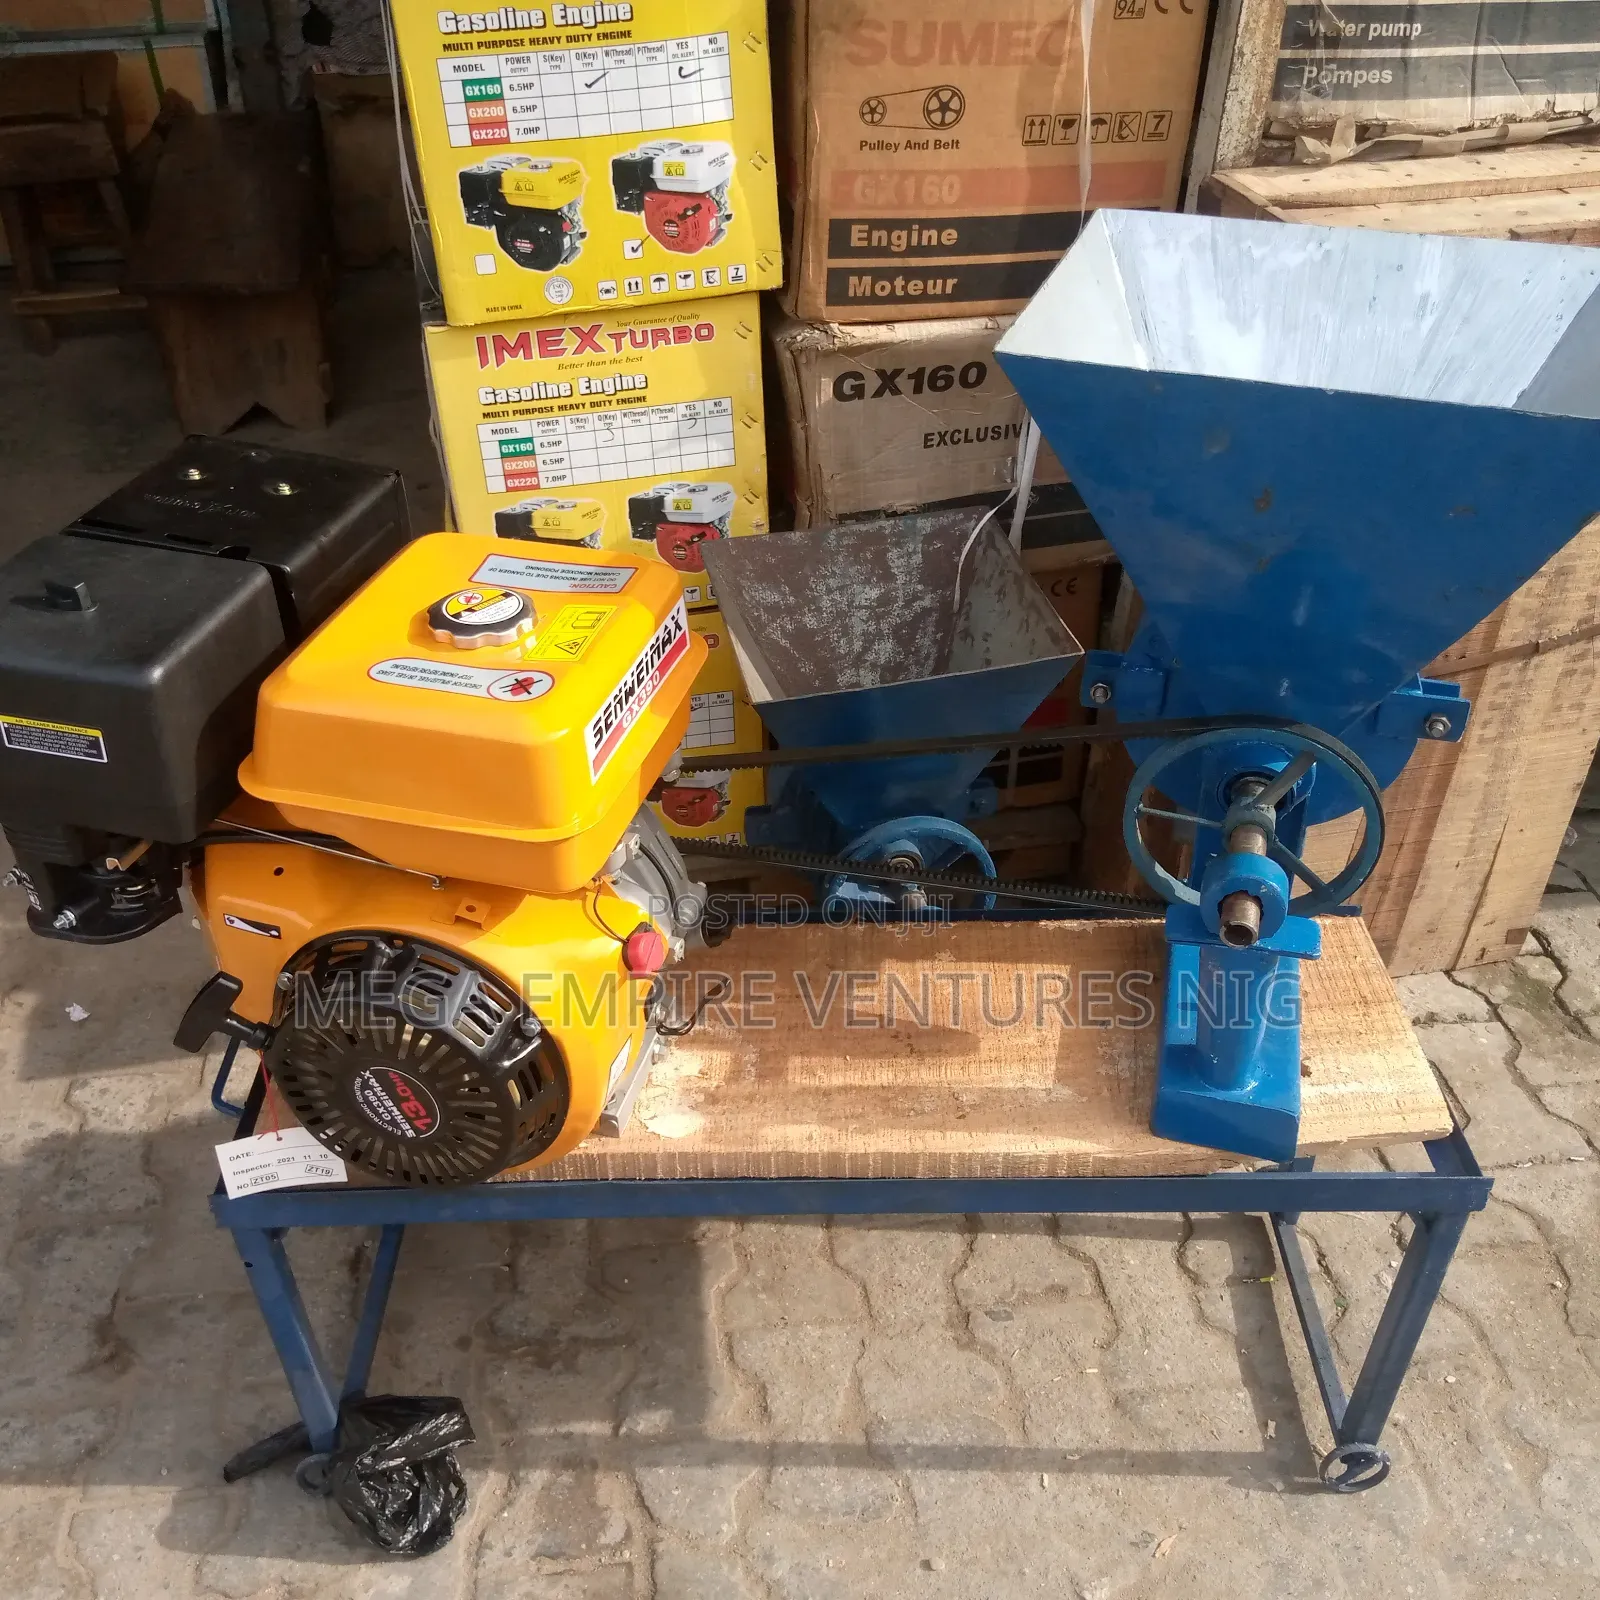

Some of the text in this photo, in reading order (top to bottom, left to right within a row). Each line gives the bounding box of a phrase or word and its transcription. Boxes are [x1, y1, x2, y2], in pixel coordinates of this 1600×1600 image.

[437, 2, 633, 35] Gasoline Engine
[1368, 22, 1422, 41] pump
[442, 30, 633, 52] MULTI PURPOSE HEAVY DUTY ENGINE
[676, 41, 690, 50] YES
[708, 37, 718, 46] NO
[844, 19, 1080, 67] SUMEC
[604, 47, 635, 58] W(Thread)
[637, 44, 666, 55] P(Thread)
[505, 56, 532, 65] POWER
[542, 54, 566, 63] S(Key)
[453, 61, 486, 73] MODEL
[510, 66, 529, 74] OUTPUT
[1303, 64, 1393, 88] Pompes
[465, 84, 502, 97] GX160
[509, 82, 535, 92] 6.5HP
[469, 106, 505, 119] GX200
[512, 104, 538, 114] 6.5HP
[472, 128, 508, 140] GX220
[515, 126, 541, 136] 7.0HP
[859, 137, 960, 153] Pulley And Belt
[853, 173, 963, 206] GX160
[850, 223, 958, 252] Engine
[848, 274, 958, 298] Moteur
[617, 313, 701, 328] Your Guarantee of Quality
[475, 322, 716, 371] IMEX TURBO
[557, 355, 643, 371] Better than the best
[832, 360, 988, 403] GX160
[477, 372, 649, 406] Gasoline Engine
[482, 395, 648, 419] MULTI PURPOSE HEAVY DUTY ENGINE
[685, 403, 697, 411] YES
[713, 400, 723, 408] NO
[622, 407, 650, 418] W(Thread)
[651, 405, 676, 416] P(Thread)
[536, 419, 560, 428] POWER
[570, 416, 590, 425] S(Key)
[491, 426, 520, 436] MODEL
[923, 422, 1030, 449] EXCLUSIV
[501, 442, 534, 454] GX160
[540, 440, 563, 449] 6.5HP
[504, 459, 536, 471] GX200
[542, 457, 565, 466] 6.5HP
[507, 477, 538, 488] GX220
[544, 474, 567, 483] 7.0HP
[498, 568, 526, 576] DANGER
[524, 565, 560, 573] POISONING
[1051, 576, 1078, 597] CE
[376, 669, 395, 678] LEAKS
[395, 673, 408, 681] FUEL
[438, 671, 459, 679] ENGINE
[458, 673, 474, 681] STOP
[592, 606, 684, 750] SENWEIMAX
[418, 676, 430, 684] FUEL
[621, 670, 662, 729] GX390
[26, 720, 51, 728] CLEANER
[51, 724, 88, 734] MAINTENANCE
[354, 1077, 402, 1136] ELECTRONIC IGNITION
[360, 1070, 417, 1138] SENWEIMAX
[364, 1089, 392, 1121] GX390
[388, 1072, 433, 1131] 13.0HP
[229, 1151, 254, 1162] DATE:
[232, 1162, 274, 1176] Inspector:
[277, 1156, 296, 1164] 2021
[306, 1165, 331, 1176] ZT19
[252, 1174, 278, 1185] ZT05
